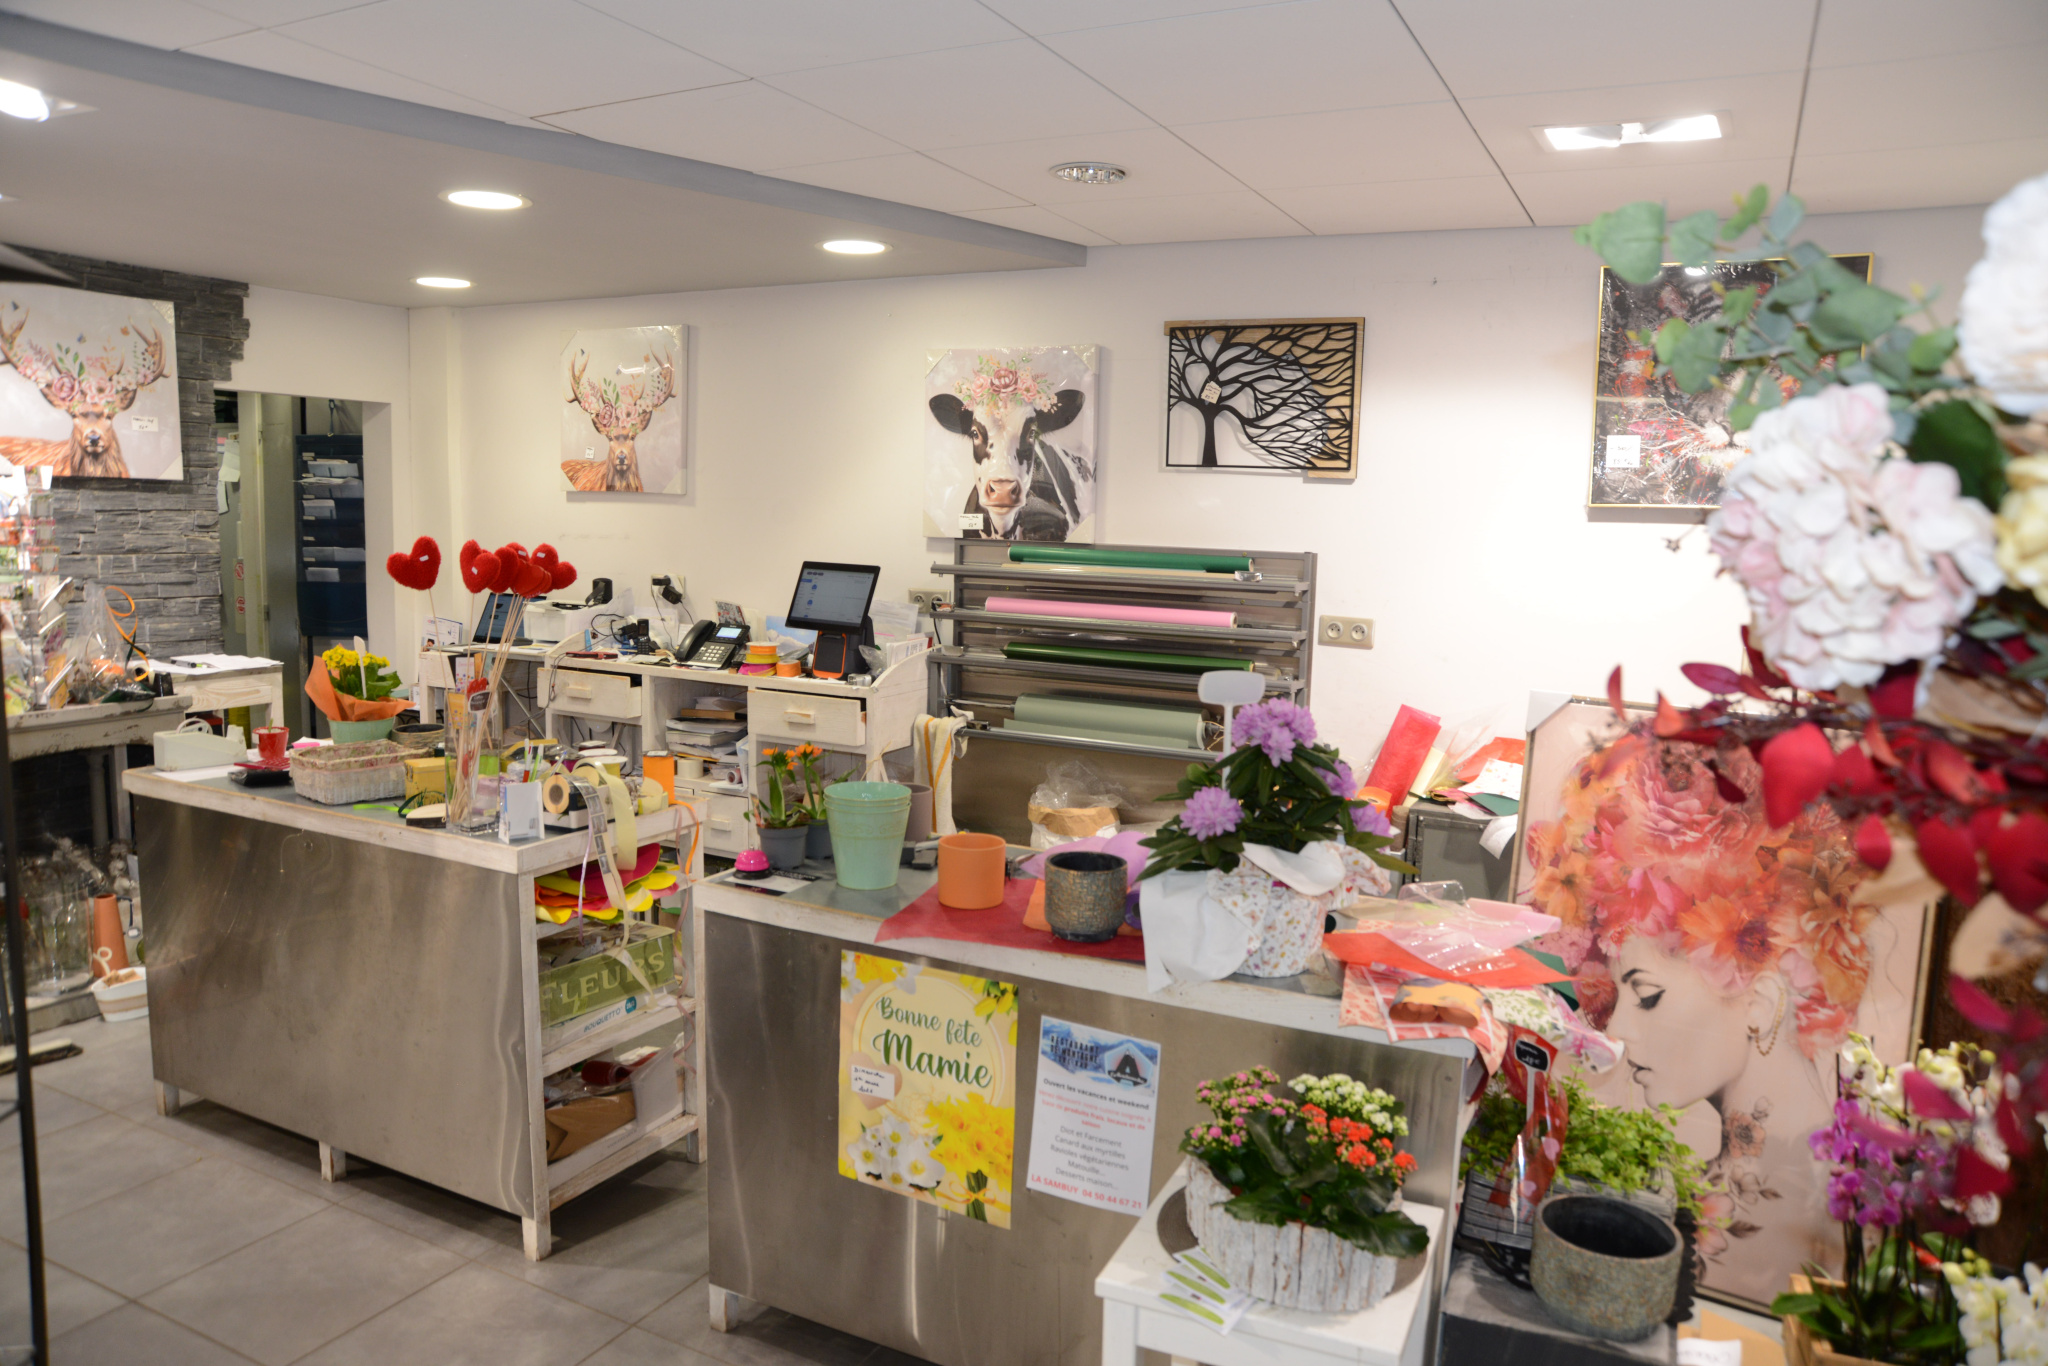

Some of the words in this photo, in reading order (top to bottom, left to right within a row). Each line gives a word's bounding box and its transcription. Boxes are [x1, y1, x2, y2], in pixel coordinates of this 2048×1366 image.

[876, 996, 941, 1031] Bonne
[946, 1018, 983, 1047] fête
[1050, 1035, 1099, 1052] RESTAURANT
[1061, 1048, 1098, 1064] MONTAGNE
[872, 1028, 993, 1088] Mamie
[1043, 1078, 1066, 1090] Ouvert
[1066, 1084, 1076, 1093] les
[1077, 1088, 1107, 1102] vacances
[1109, 1096, 1116, 1104] et
[1117, 1098, 1150, 1110] weekend
[1063, 1105, 1090, 1118] produits
[1106, 1116, 1128, 1127] locaux
[1128, 1121, 1136, 1129] et
[1137, 1122, 1146, 1131] de
[1054, 1135, 1080, 1148] Canard
[1081, 1143, 1093, 1152] aux
[1095, 1145, 1126, 1160] myrtilles
[1060, 1125, 1075, 1136] Diot
[1075, 1130, 1084, 1138] et
[1084, 1131, 1123, 1148] Farcement
[1050, 1143, 1078, 1159] Ravioles
[1079, 1152, 1129, 1171] végétariennes
[1055, 1167, 1086, 1182] Desserts
[1031, 1174, 1042, 1184] LA
[1043, 1177, 1079, 1194] SAMBUY
[1082, 1189, 1093, 1199] 04
[1094, 1192, 1105, 1202] 50
[1107, 1195, 1118, 1205] 44
[1118, 1198, 1130, 1207] 67
[1132, 1200, 1142, 1209] 21
